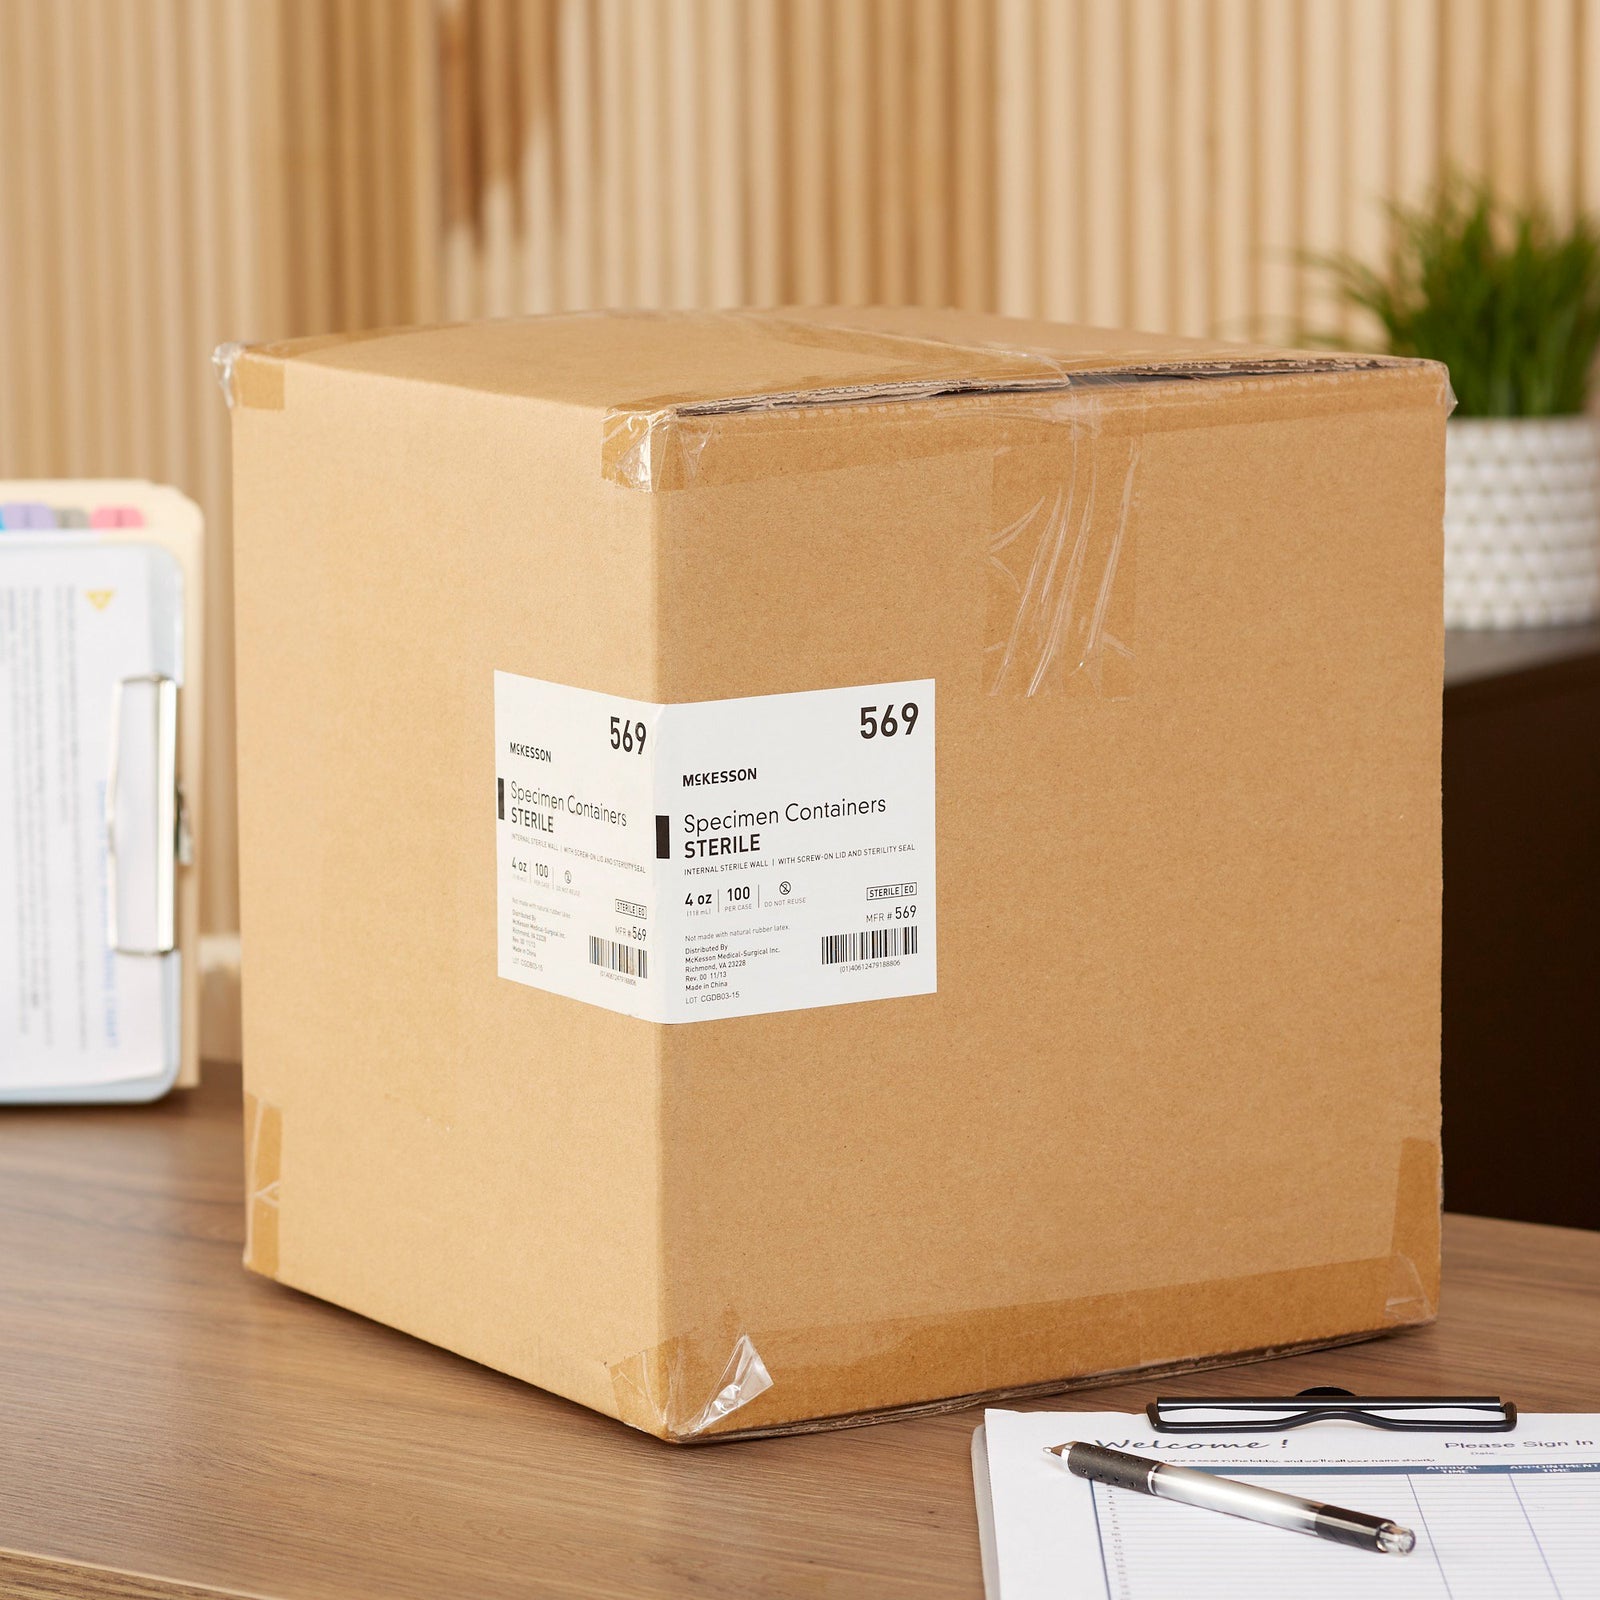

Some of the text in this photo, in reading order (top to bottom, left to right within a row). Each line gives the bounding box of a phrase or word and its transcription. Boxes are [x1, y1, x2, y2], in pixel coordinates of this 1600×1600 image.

[860, 702, 919, 739] 569
[610, 716, 647, 755] 569
[511, 780, 627, 827] Specimen Containers
[511, 806, 554, 833] STERILE
[684, 798, 886, 837] Specimen Containers
[684, 833, 760, 859] STERILE
[512, 856, 527, 872] 4 oz
[684, 844, 916, 876] INTERNAL STERILE WALL WITH SCREW-ON LID AND STERILITY SEAL
[535, 862, 548, 878] 100
[634, 864, 646, 874] SEAL
[684, 892, 712, 906] 4 oz
[727, 886, 750, 902] 100
[870, 886, 900, 898] STERILE
[616, 901, 636, 914] STERILE
[764, 900, 772, 908] DO
[866, 904, 917, 923] MFR # 569
[632, 926, 646, 942] 569
[730, 928, 751, 937] natural
[752, 926, 772, 934] rubber
[685, 944, 728, 954] Distributed By
[685, 955, 716, 964] McKesson
[718, 948, 768, 960] Medical-Surgical
[685, 964, 718, 973] Richmond,
[728, 960, 746, 968] 23228
[710, 971, 727, 980] 11/13
[685, 980, 728, 992] Made in China
[685, 996, 698, 1004] LOT
[1095, 1439, 1271, 1449] Welcome
[1523, 1440, 1569, 1448] Sign
